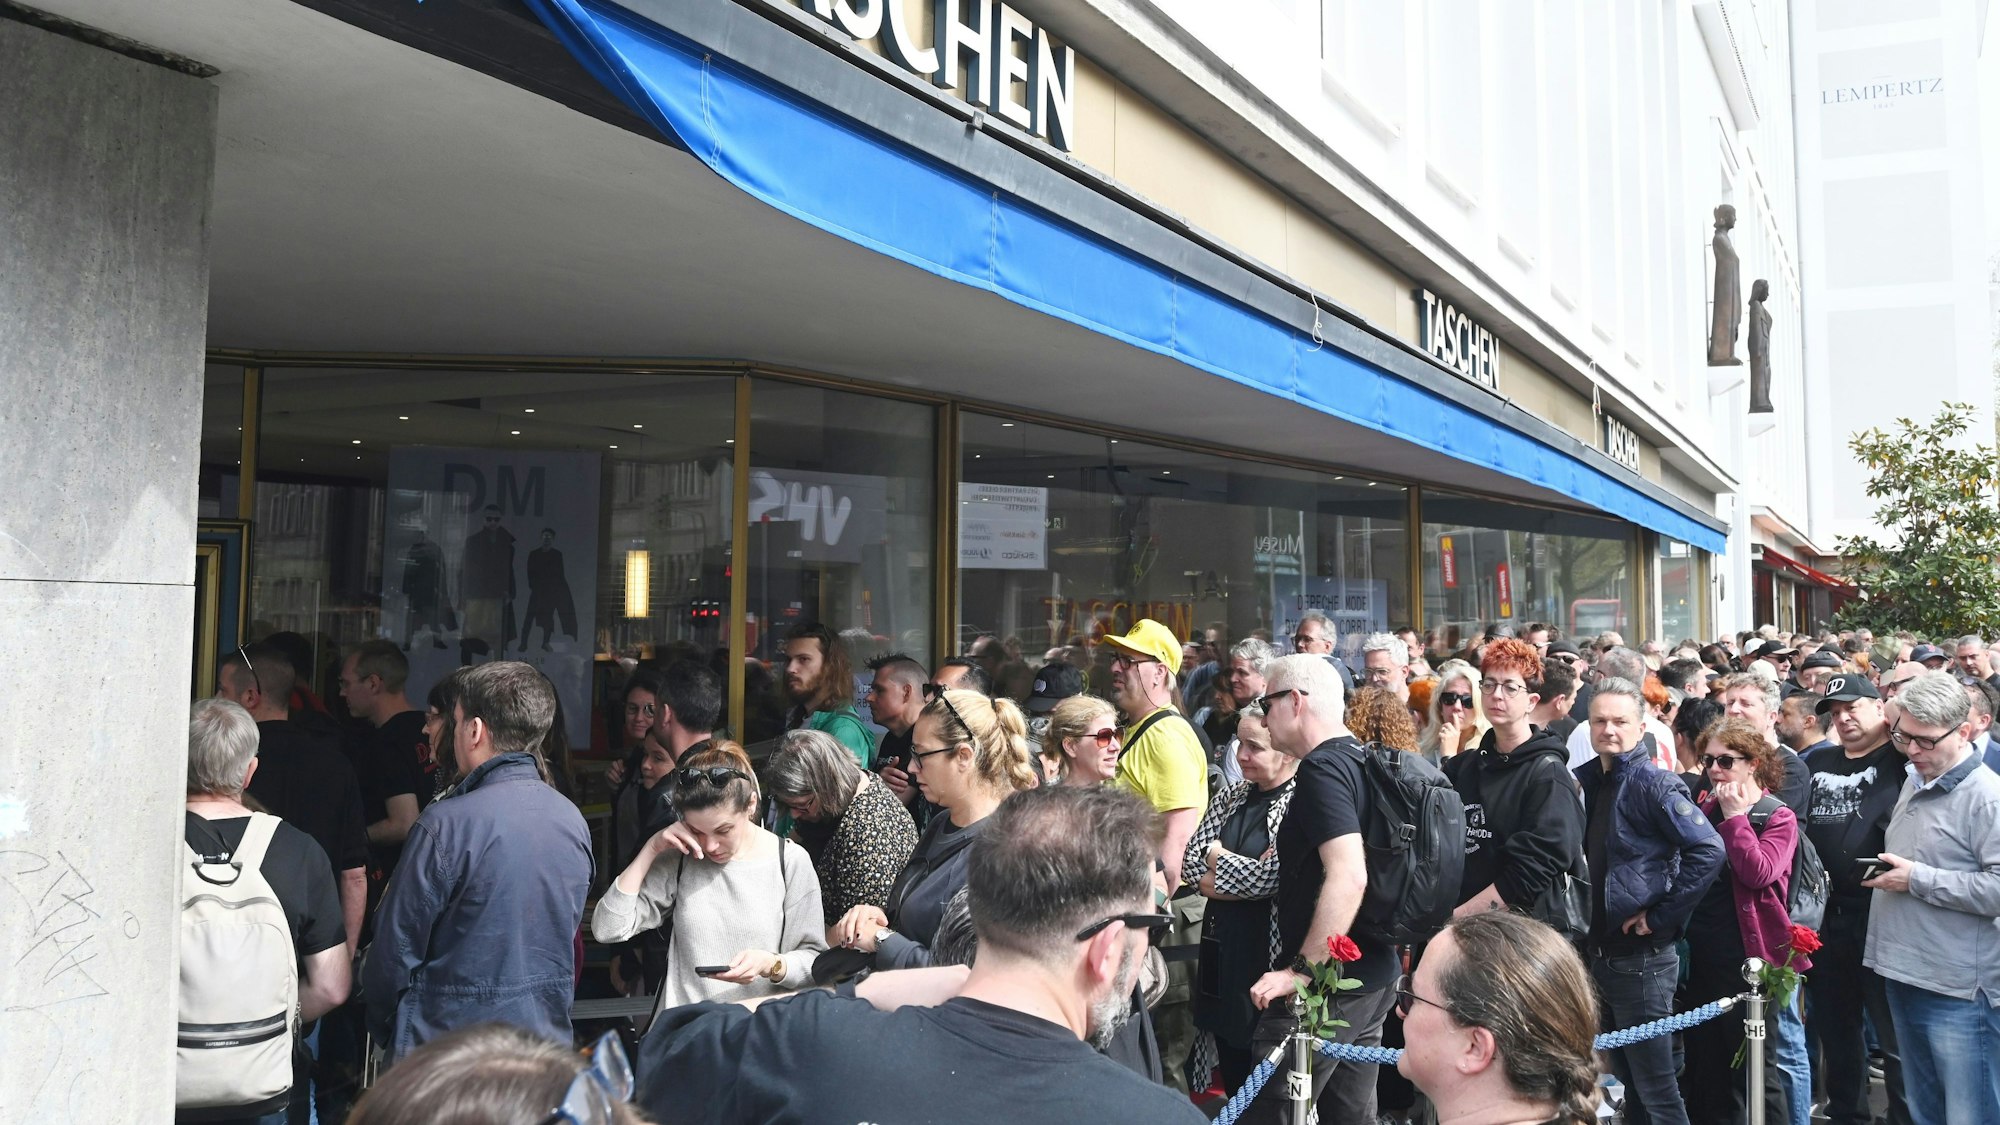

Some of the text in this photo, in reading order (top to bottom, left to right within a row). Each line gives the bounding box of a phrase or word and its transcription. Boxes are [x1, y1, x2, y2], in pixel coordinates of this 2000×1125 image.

[1822, 77, 1944, 105] LEMPERTZ
[1421, 288, 1501, 390] TASCHEN
[1606, 414, 1641, 474] TASCHEN
[443, 462, 546, 518] DM
[1297, 594, 1367, 611] DEPECHE MODE
[1339, 619, 1379, 635] CORBIJN
